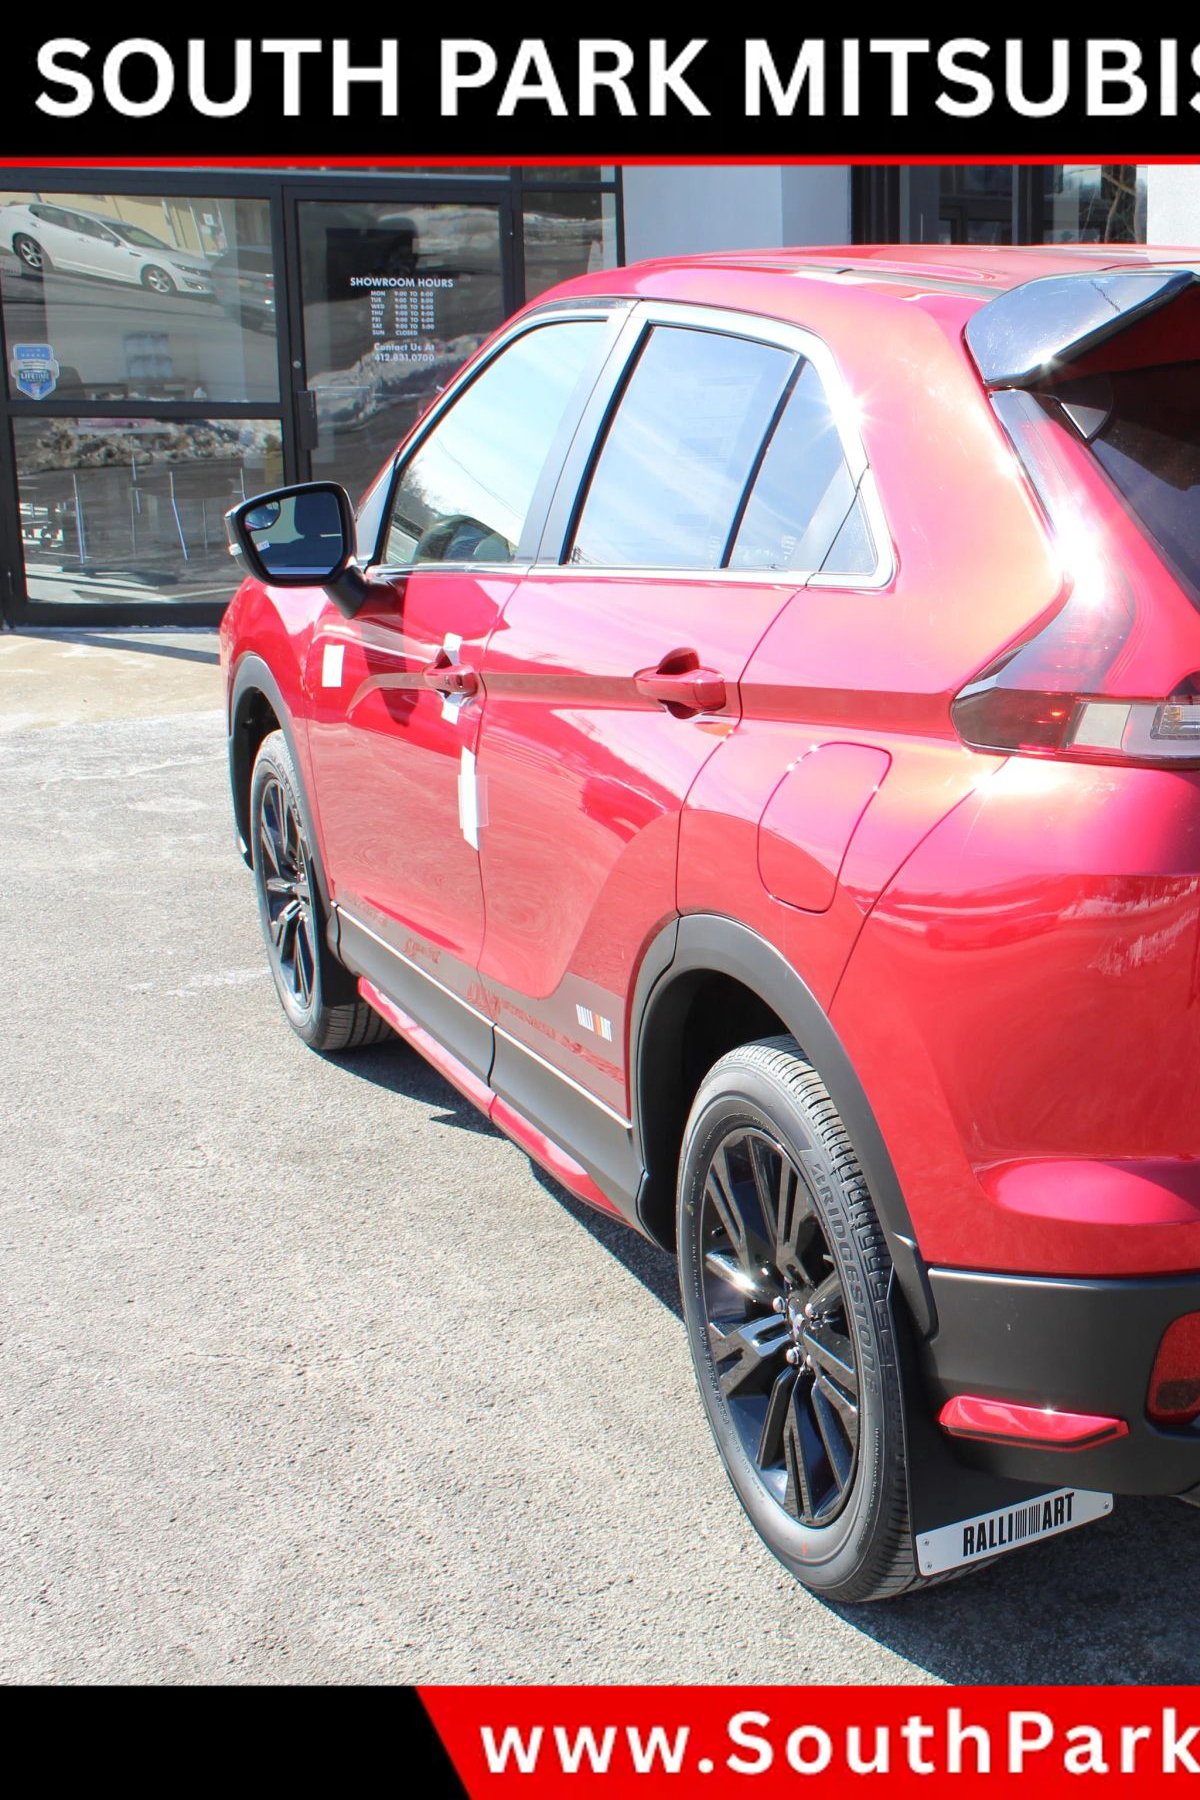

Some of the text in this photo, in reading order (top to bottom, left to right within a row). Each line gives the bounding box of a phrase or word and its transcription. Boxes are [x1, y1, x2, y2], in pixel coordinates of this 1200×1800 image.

[350, 277, 454, 288] SHOWROOM HOURS
[374, 343, 435, 351] Contact Us At
